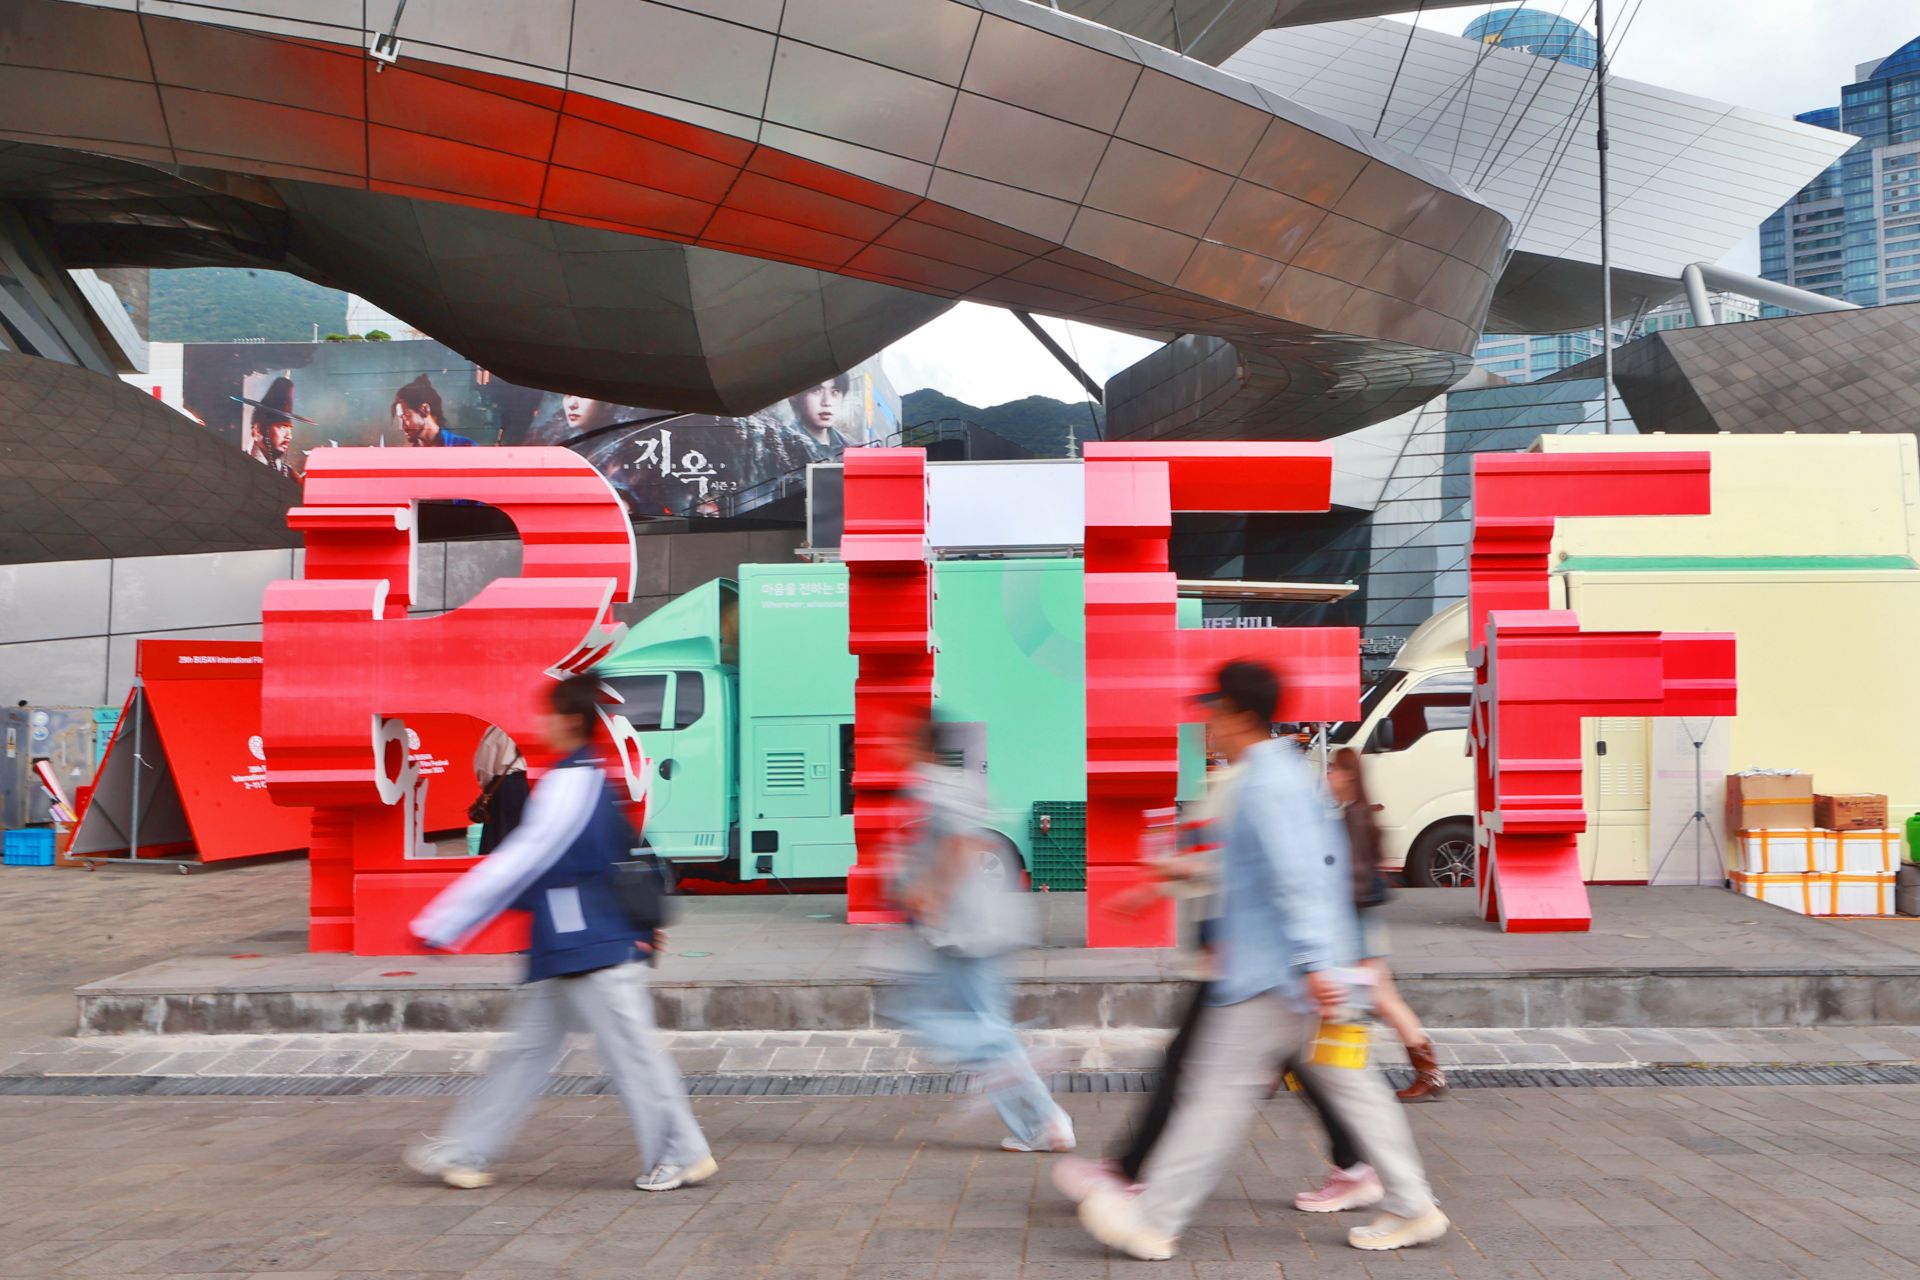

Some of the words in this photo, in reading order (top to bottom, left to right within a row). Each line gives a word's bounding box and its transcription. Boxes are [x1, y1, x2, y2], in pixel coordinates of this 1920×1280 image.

[633, 428, 717, 499] 지옥
[730, 481, 737, 491] 2
[193, 655, 216, 664] BUSAN
